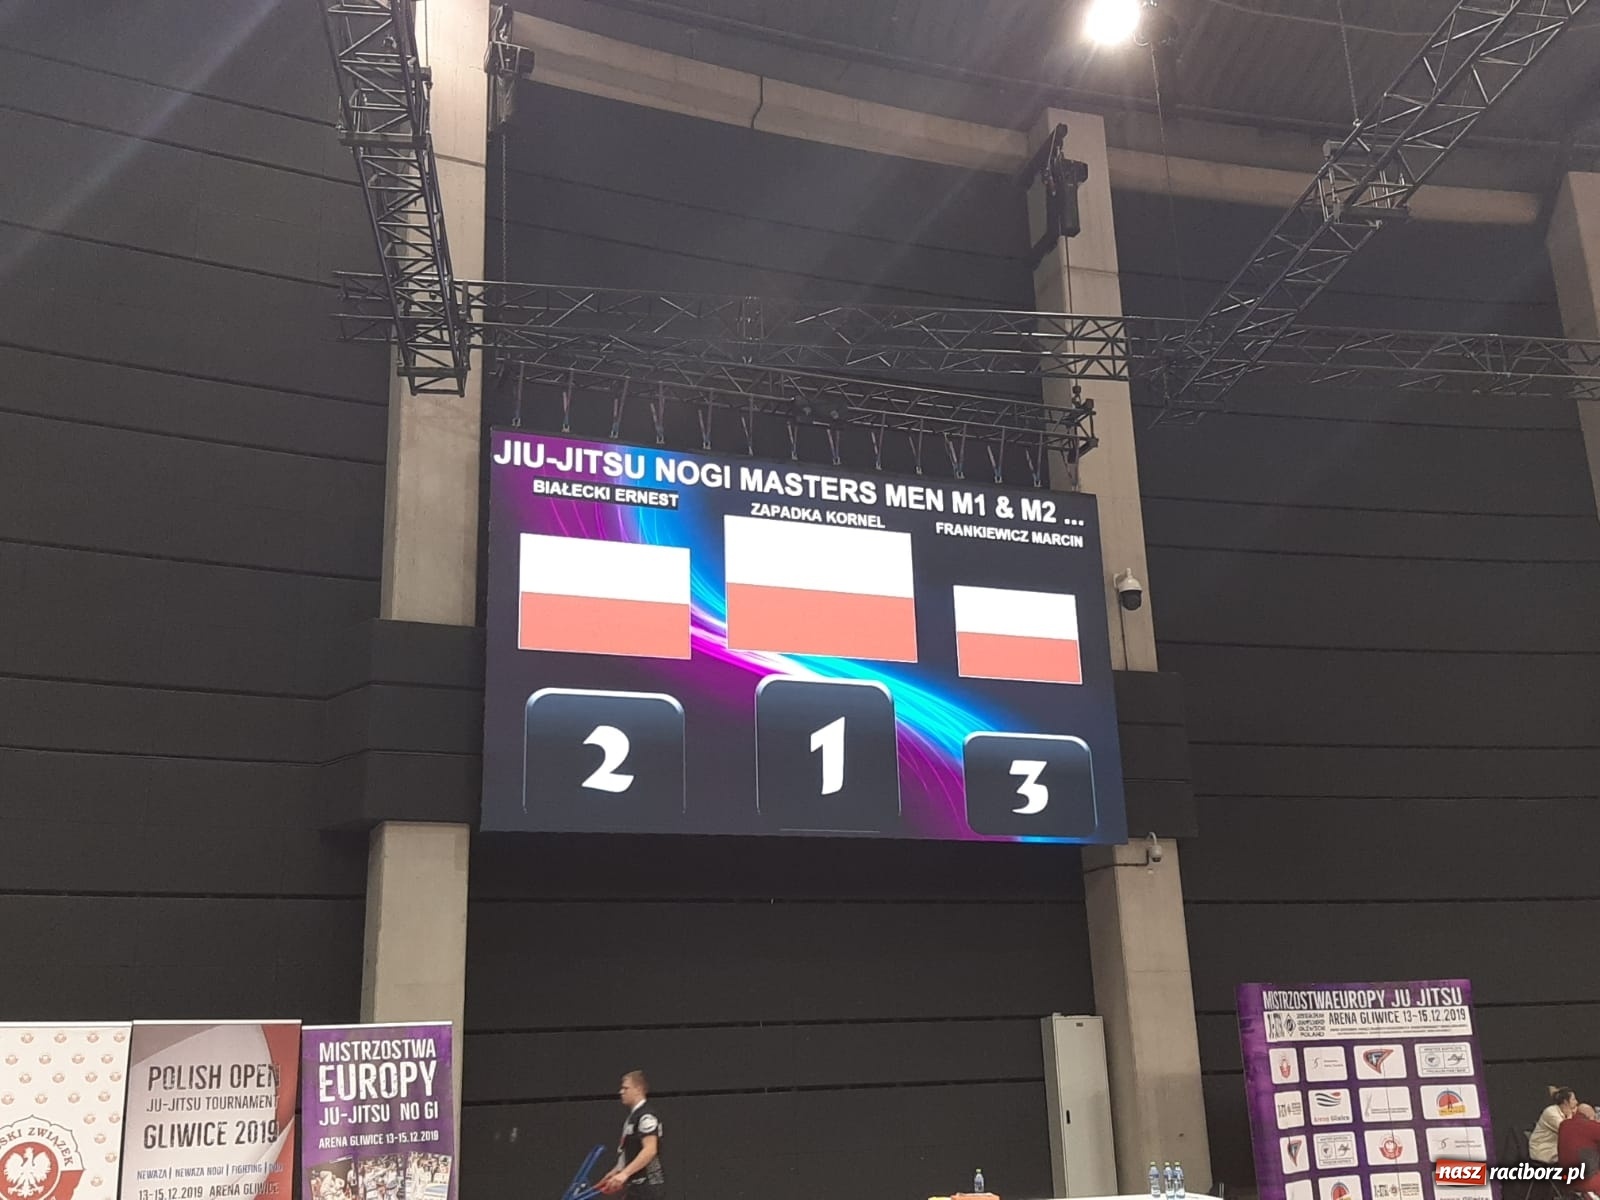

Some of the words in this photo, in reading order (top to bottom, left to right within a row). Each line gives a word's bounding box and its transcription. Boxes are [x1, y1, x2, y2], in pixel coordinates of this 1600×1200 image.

[493, 439, 645, 479] JIU-JITSU
[655, 456, 730, 489] NOGI
[740, 466, 878, 506] MASTERS
[885, 483, 944, 512] MEN
[952, 490, 986, 516] M1
[995, 496, 1015, 519] &
[1021, 499, 1057, 524] M2
[533, 479, 610, 500] BIAŁECKI
[614, 488, 680, 508] ERNEST
[750, 502, 822, 522] ZAPADKA
[826, 510, 886, 529] KORNEL
[935, 521, 1029, 543] FRANKIEWICZ
[1031, 532, 1084, 549] MARCIN
[581, 724, 635, 793] 2
[810, 716, 846, 796] 1
[1009, 759, 1050, 815] 3
[1391, 988, 1411, 1008] JU
[1416, 986, 1463, 1007] JITSU
[1329, 1011, 1358, 1025] ARENA
[1360, 1010, 1400, 1025] GLIWICE
[319, 1038, 437, 1063] MISTRZOSTWA
[148, 1065, 222, 1091] POLISH
[229, 1063, 281, 1089] OPEN
[318, 1060, 438, 1103] EUROPY
[146, 1096, 202, 1113] JU-JITSU
[205, 1093, 280, 1111] TOURNAMENT
[318, 1104, 390, 1126] JU-JITSU
[400, 1102, 420, 1121] NO
[424, 1101, 439, 1120] GI
[143, 1121, 227, 1149] GLIWICE
[234, 1119, 279, 1146] 2019
[319, 1135, 348, 1150] ARENA
[350, 1133, 384, 1147] GLIWICE
[136, 1168, 168, 1180] NEWAZA
[175, 1166, 205, 1178] NEWAZA
[209, 1183, 241, 1198] ARENA
[243, 1181, 280, 1196] GLIWICE
